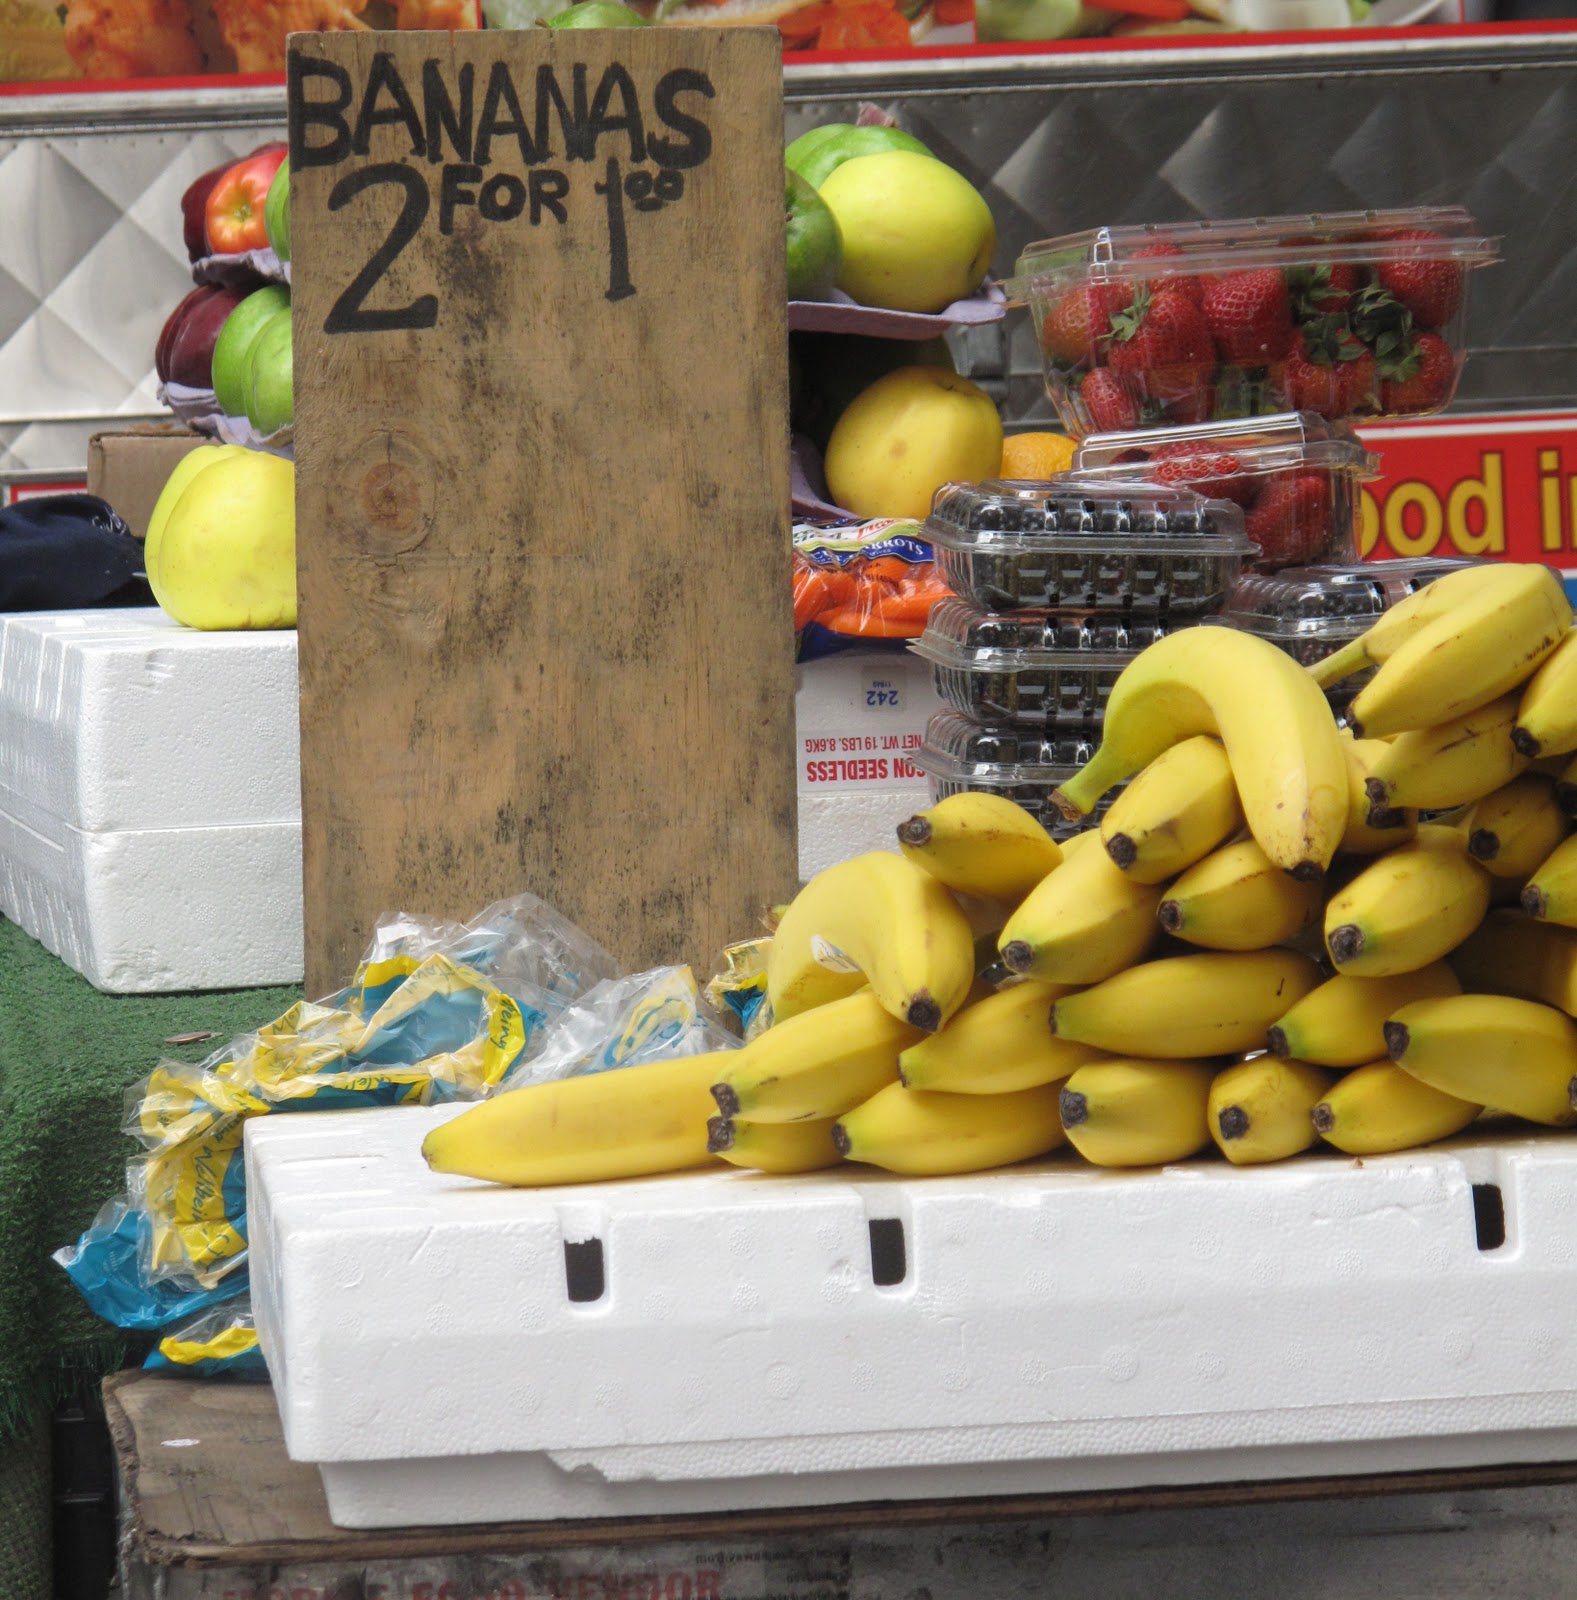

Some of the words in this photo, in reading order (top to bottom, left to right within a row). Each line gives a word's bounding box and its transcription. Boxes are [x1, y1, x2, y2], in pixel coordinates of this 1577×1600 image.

[289, 49, 717, 172] BANANAS
[324, 162, 439, 335] 2
[440, 163, 570, 236] FOR
[866, 690, 899, 706] 242
[805, 737, 836, 753] 8.6KG
[838, 736, 862, 752] LBS.
[864, 736, 878, 750] 19
[880, 735, 899, 750] WT.
[901, 734, 922, 750] NET
[806, 757, 888, 783] SEEDLESS
